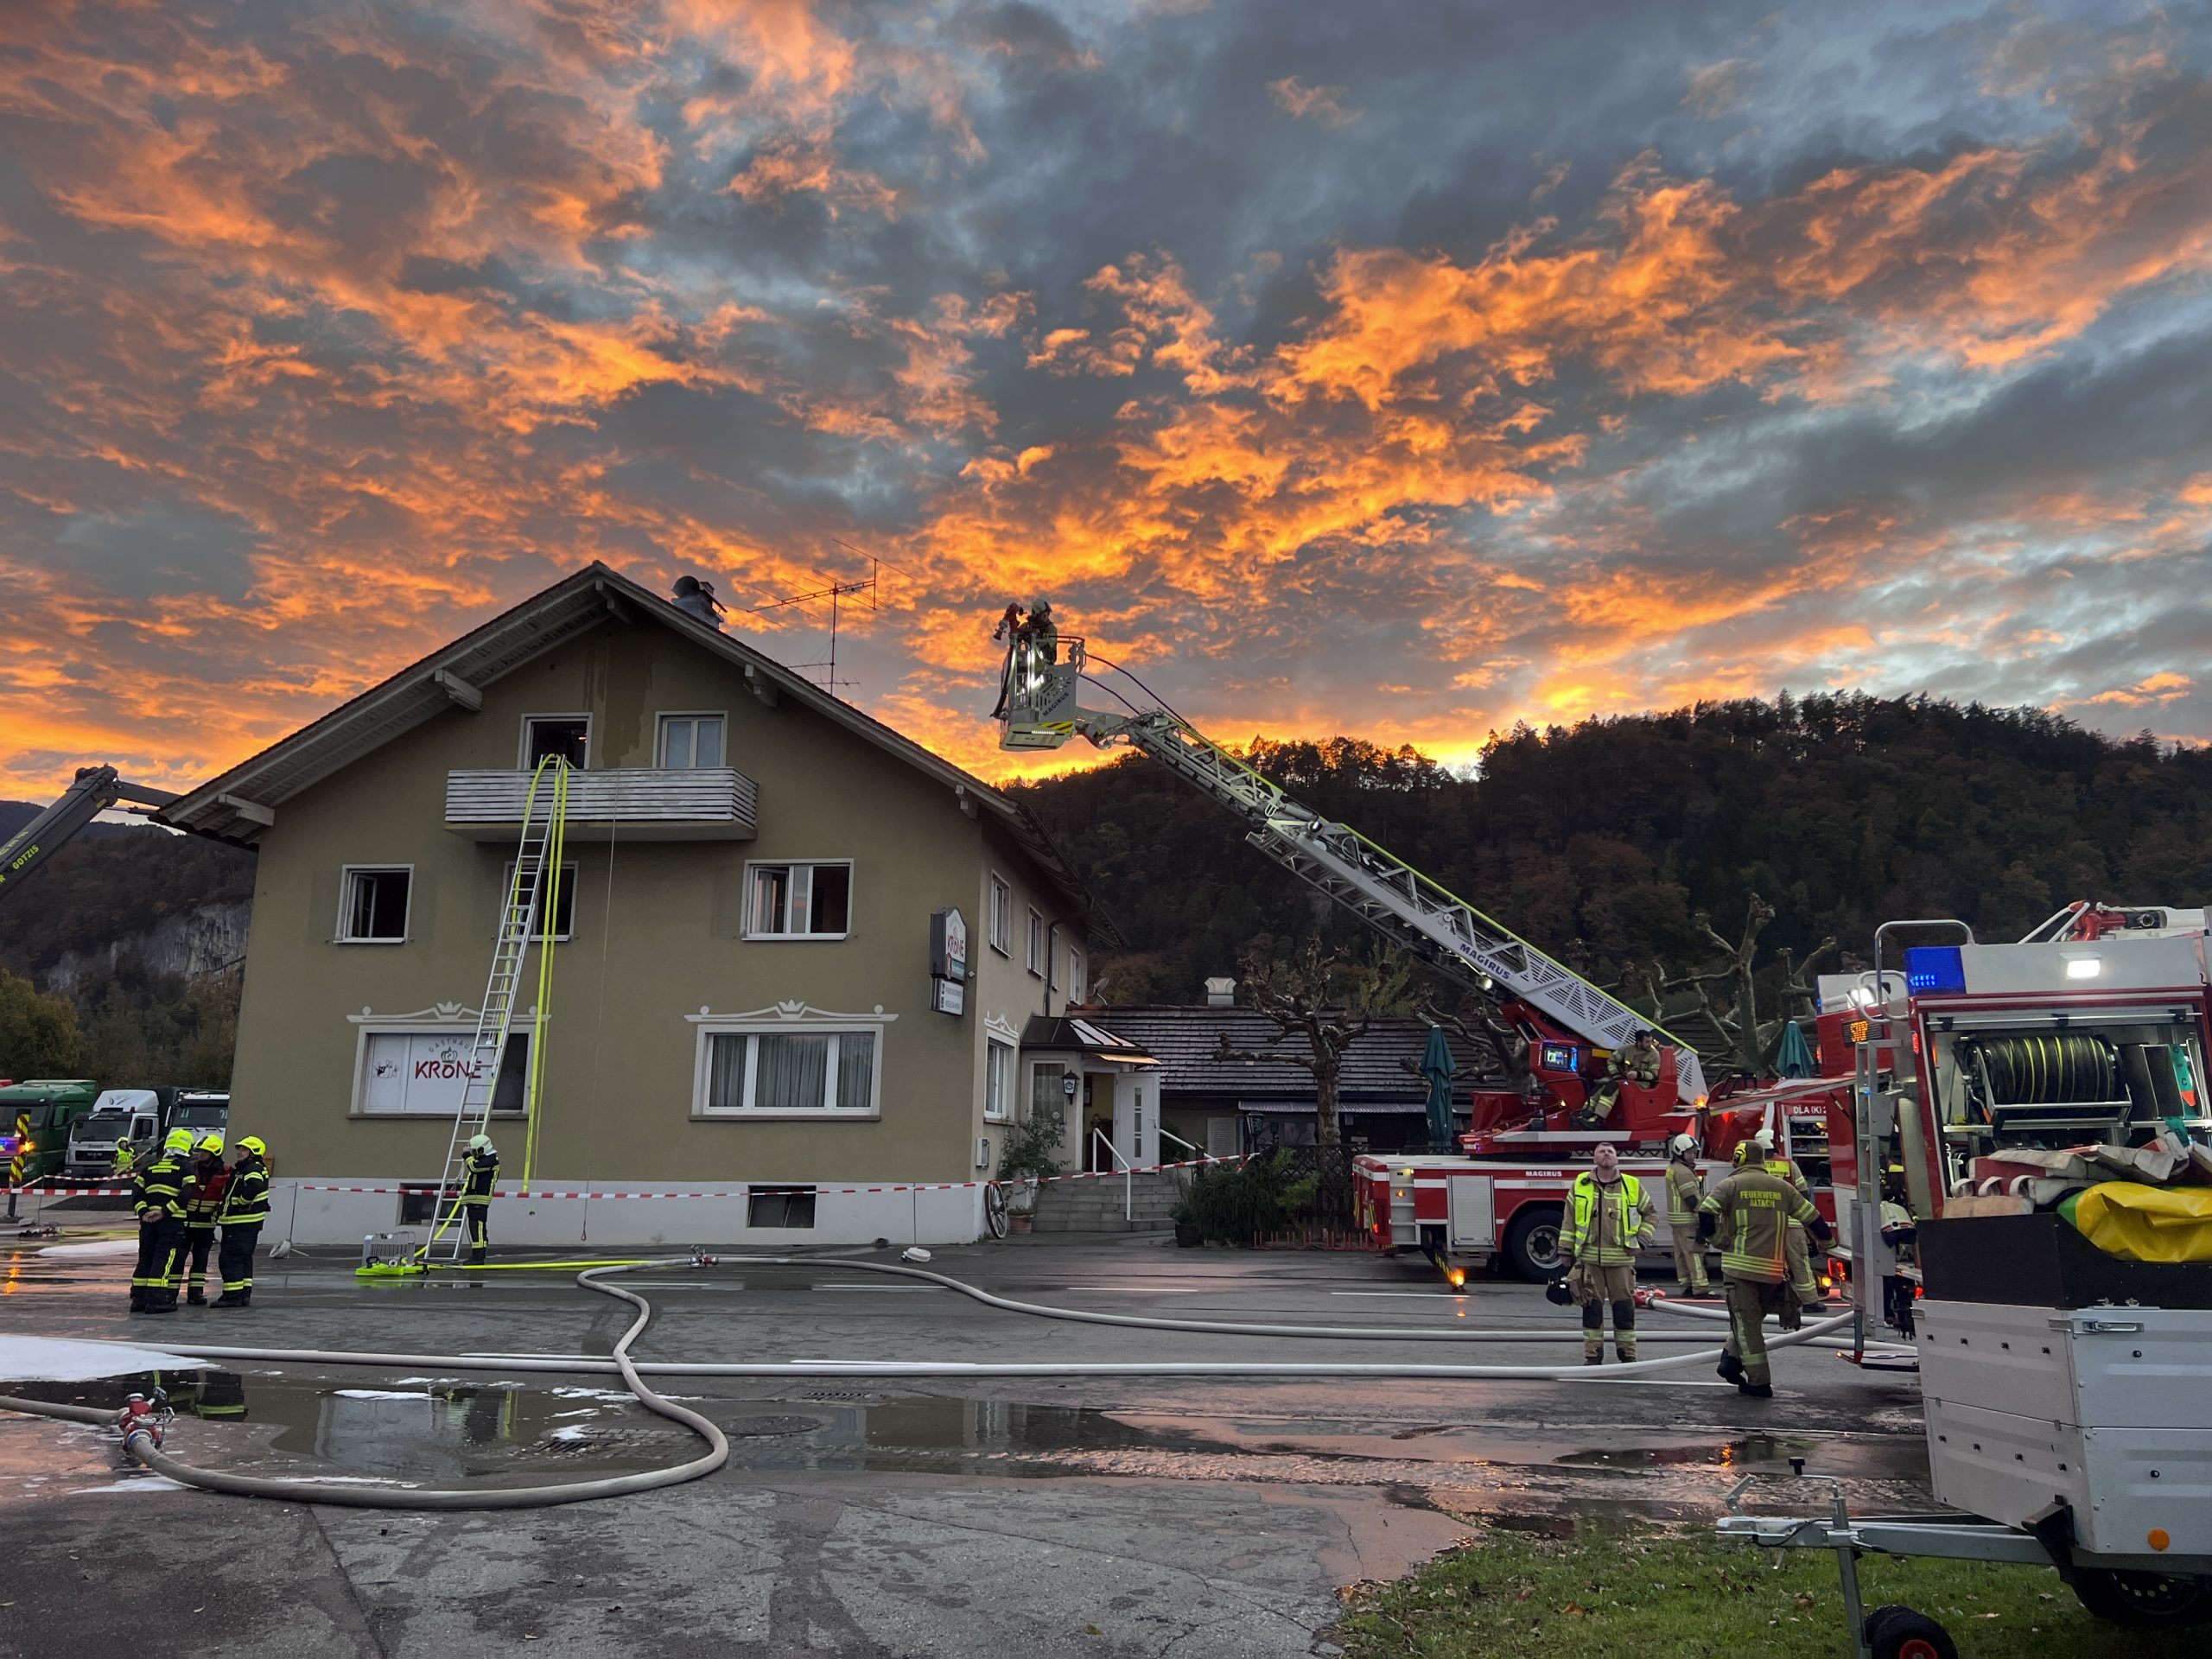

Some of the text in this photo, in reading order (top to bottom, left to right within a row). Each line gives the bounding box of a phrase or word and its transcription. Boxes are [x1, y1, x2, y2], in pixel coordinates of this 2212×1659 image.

[1042, 691, 1070, 717] MAGIRUS
[1459, 943, 1511, 980] MAGIRUS
[415, 1060, 482, 1079] KRONE
[1793, 1106, 1810, 1115] DLA
[1811, 1106, 1822, 1115] (K)
[1739, 1190, 1782, 1201] FEUERWEHR
[1750, 1198, 1776, 1209] ALTACH
